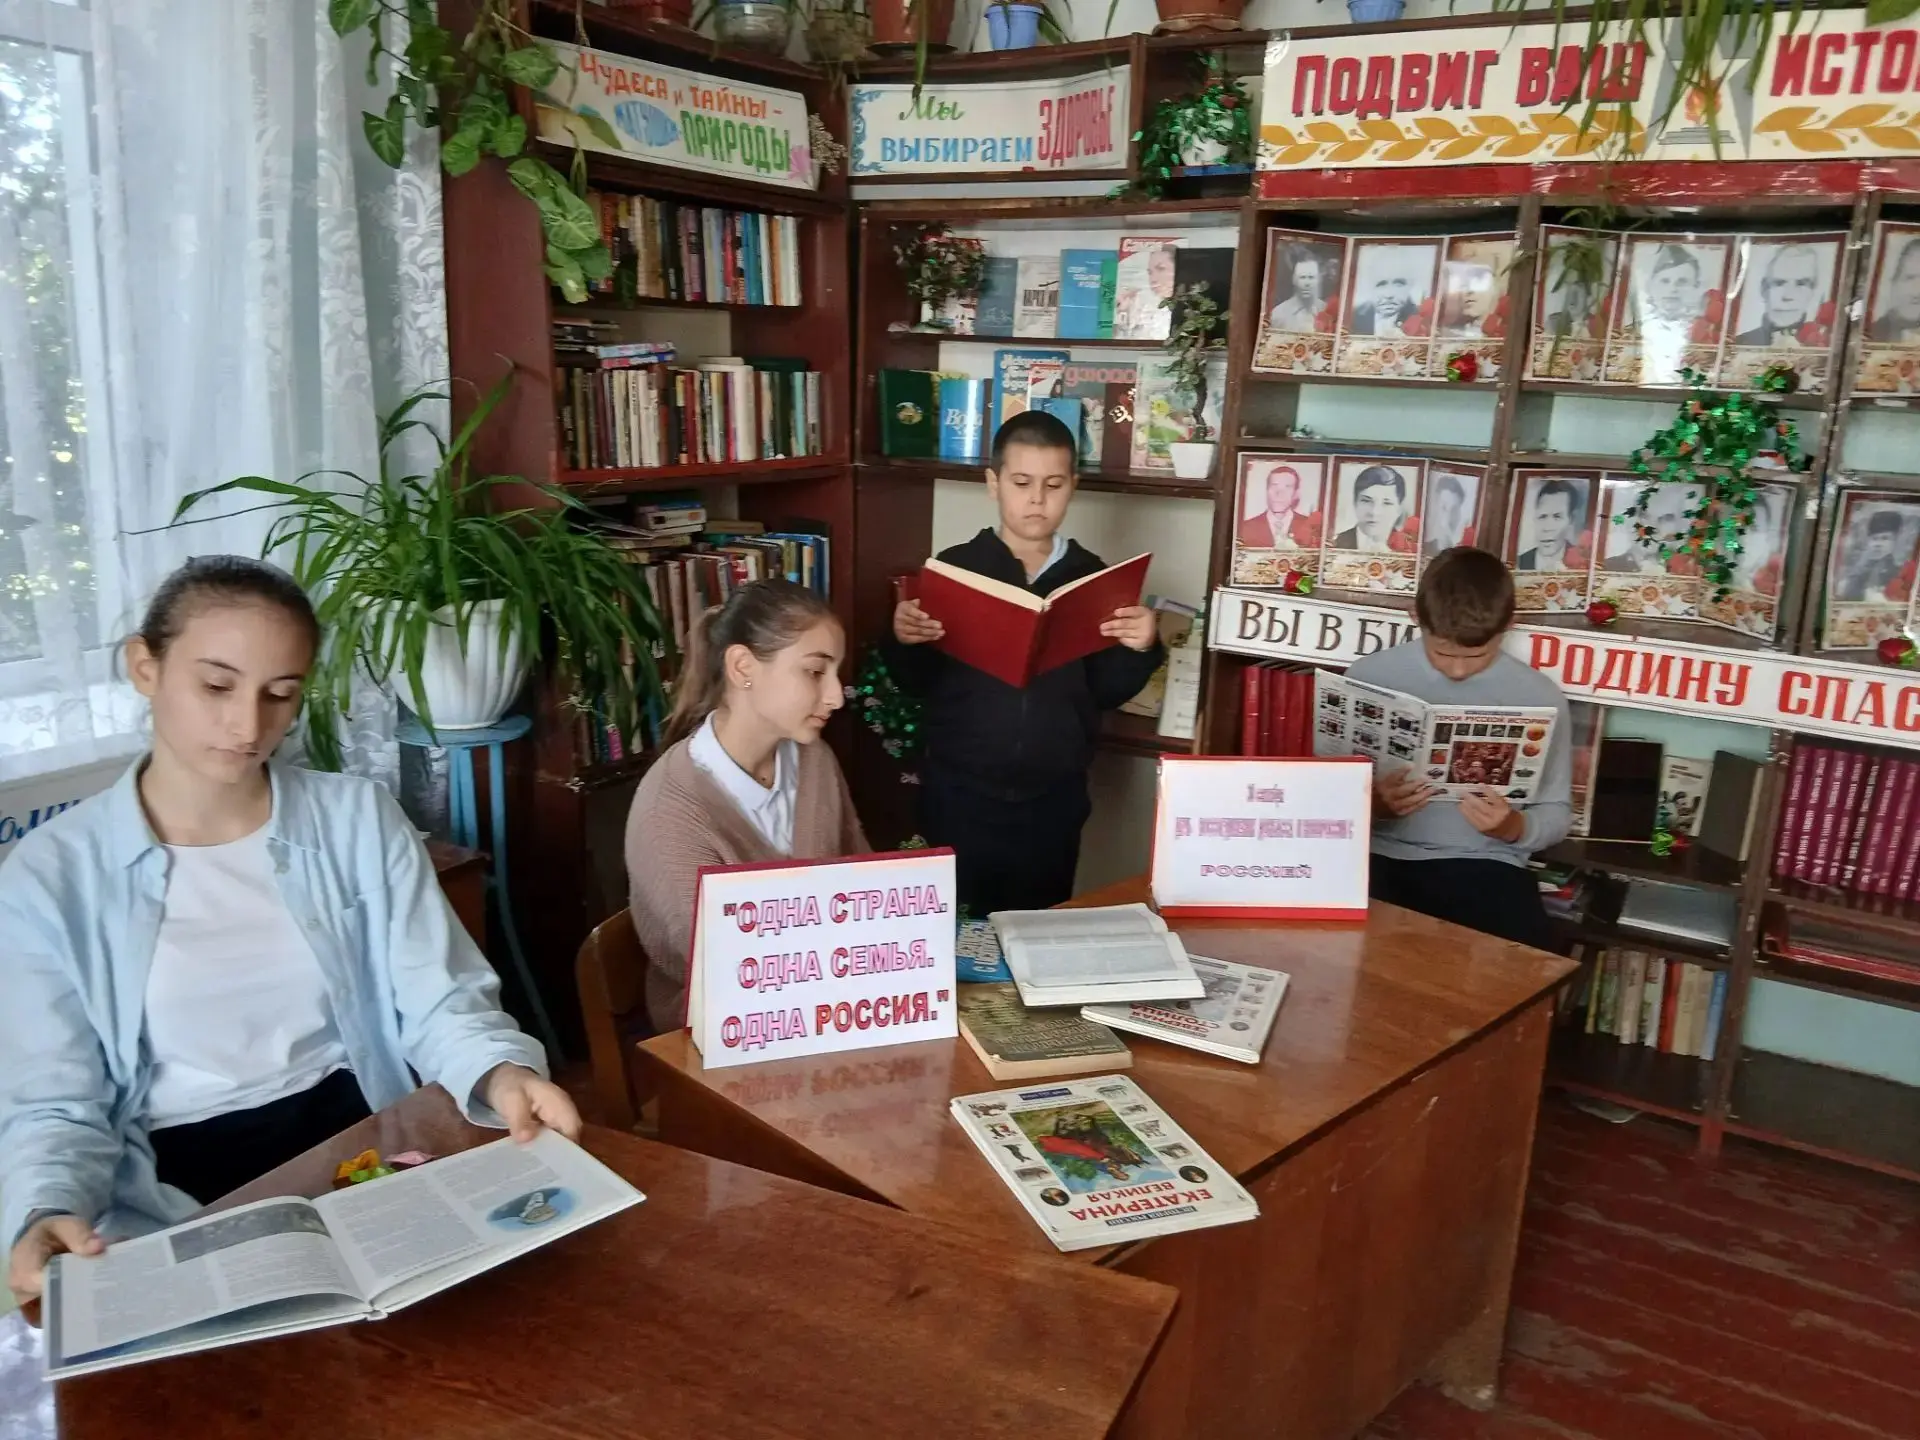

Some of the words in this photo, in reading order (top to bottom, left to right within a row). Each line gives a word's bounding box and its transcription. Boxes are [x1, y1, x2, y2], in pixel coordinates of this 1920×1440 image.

[1292, 50, 1500, 120] ПОДВИГ
[1516, 41, 1647, 107] ВАШ
[1769, 29, 1920, 97] ИСТО
[689, 84, 767, 119] ТАЙНЫ
[899, 95, 965, 122] Мы
[680, 110, 791, 173] ПРИРОДЫ
[1237, 600, 1304, 647] ВЫ
[1316, 612, 1343, 651] В
[1354, 618, 1419, 656] БИ
[1530, 633, 1752, 706] РОДИНУ
[1200, 863, 1312, 879] РОССИЕЙ
[723, 896, 822, 937] "ОДНА
[829, 885, 948, 924] СТРАНА.
[738, 950, 823, 993] ОДНА
[831, 938, 935, 978] СЕМЬЯ.
[721, 1008, 808, 1051] ОДНА
[815, 989, 949, 1036] РОССИЯ."
[1067, 1188, 1213, 1222] ЕКАТЕРИНА
[1086, 1181, 1176, 1203] ВЕЛИКАЯ
